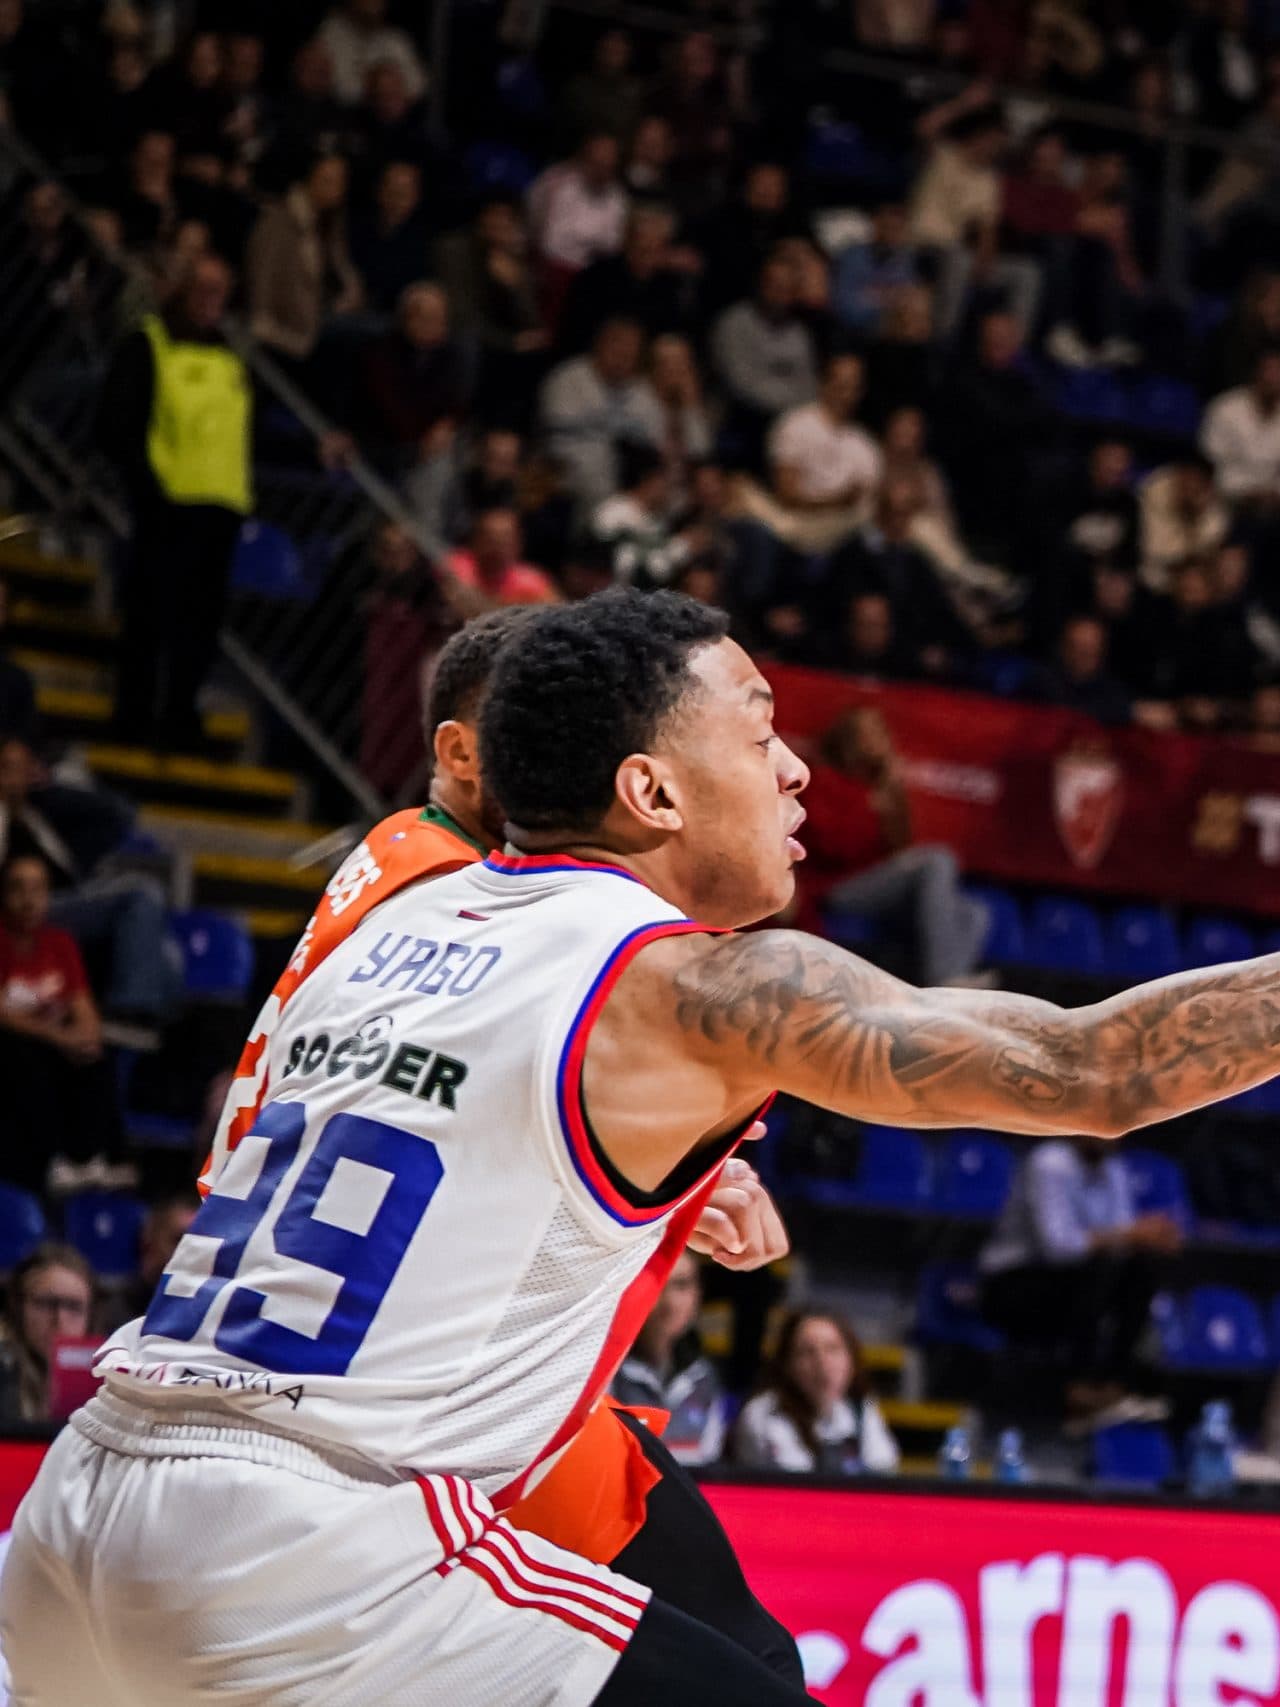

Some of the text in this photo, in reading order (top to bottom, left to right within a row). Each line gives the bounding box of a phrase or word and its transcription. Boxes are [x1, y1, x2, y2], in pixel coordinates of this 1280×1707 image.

[347, 930, 502, 997] YAGO
[282, 1030, 469, 1112] SOCCER
[140, 1099, 445, 1376] 99
